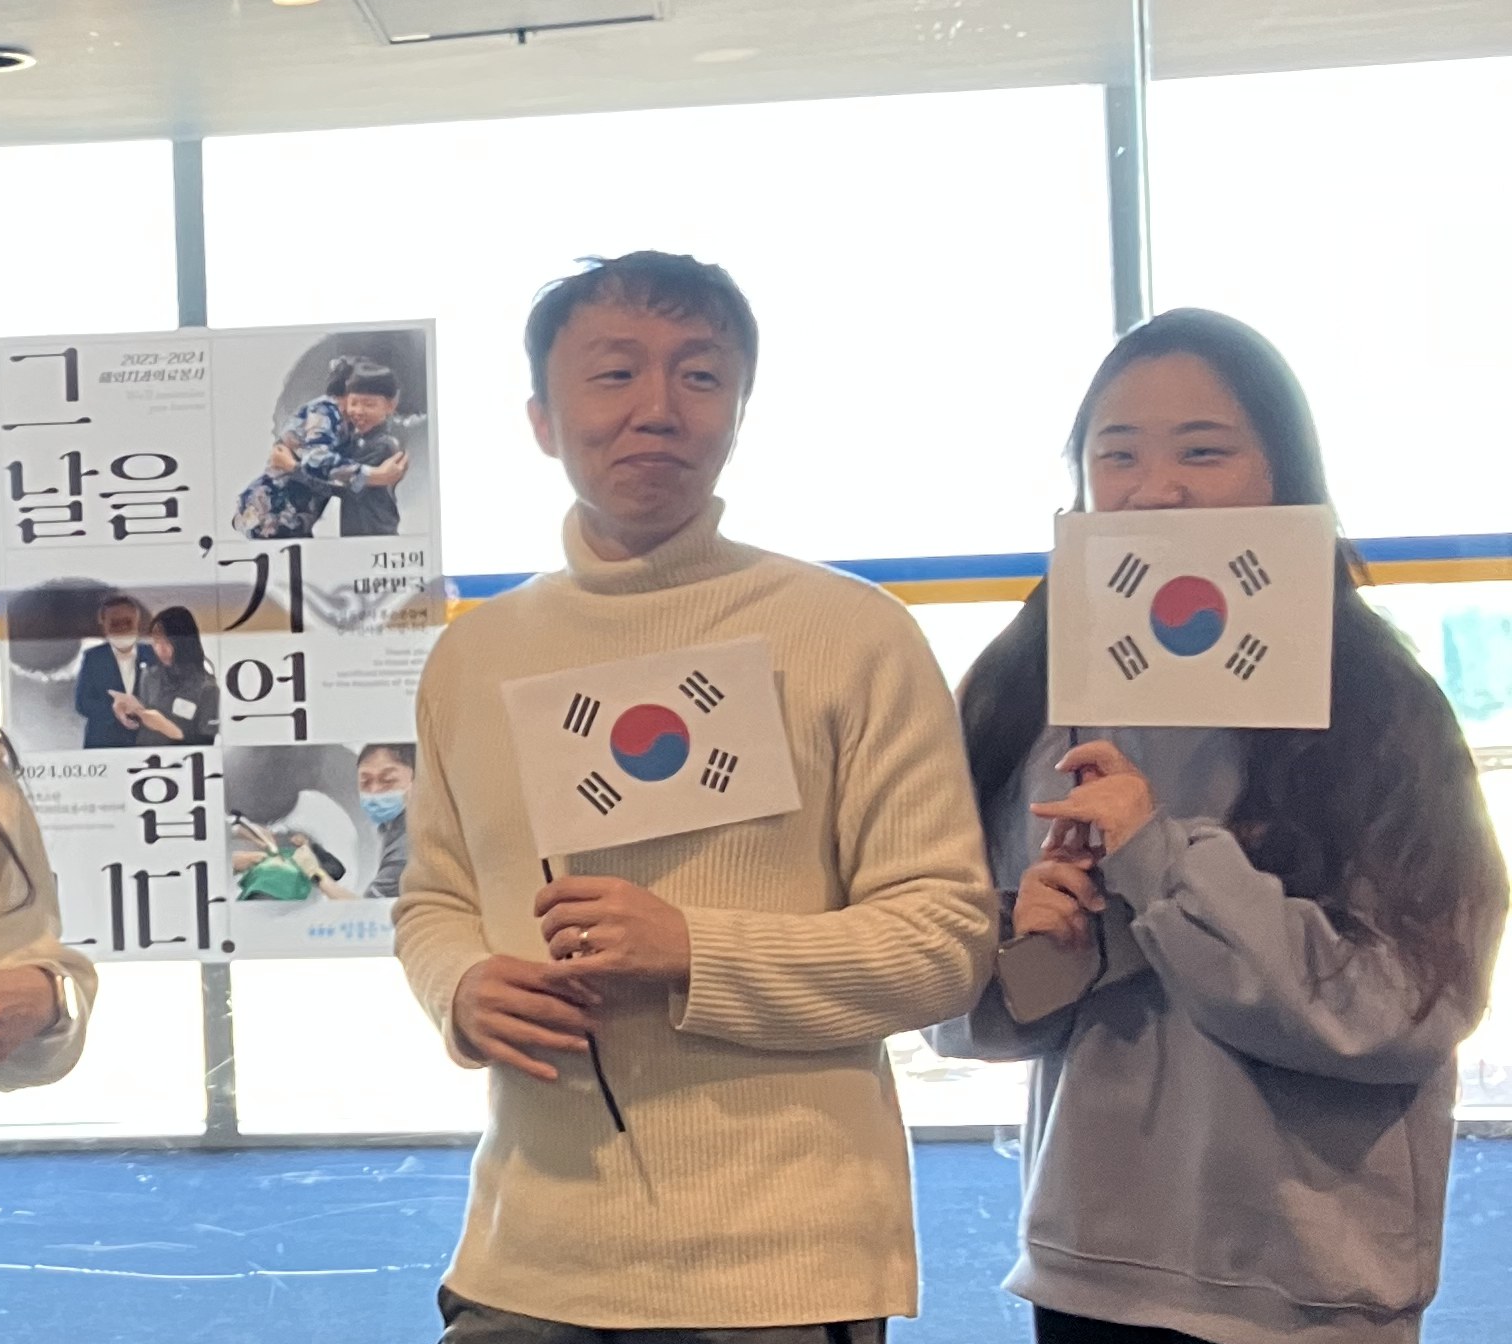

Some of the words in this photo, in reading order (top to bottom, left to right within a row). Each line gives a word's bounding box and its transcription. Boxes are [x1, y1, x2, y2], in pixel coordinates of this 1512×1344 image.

[1, 347, 92, 431] 그
[218, 544, 303, 633] 기
[226, 651, 307, 741] 억
[127, 752, 223, 844] 합
